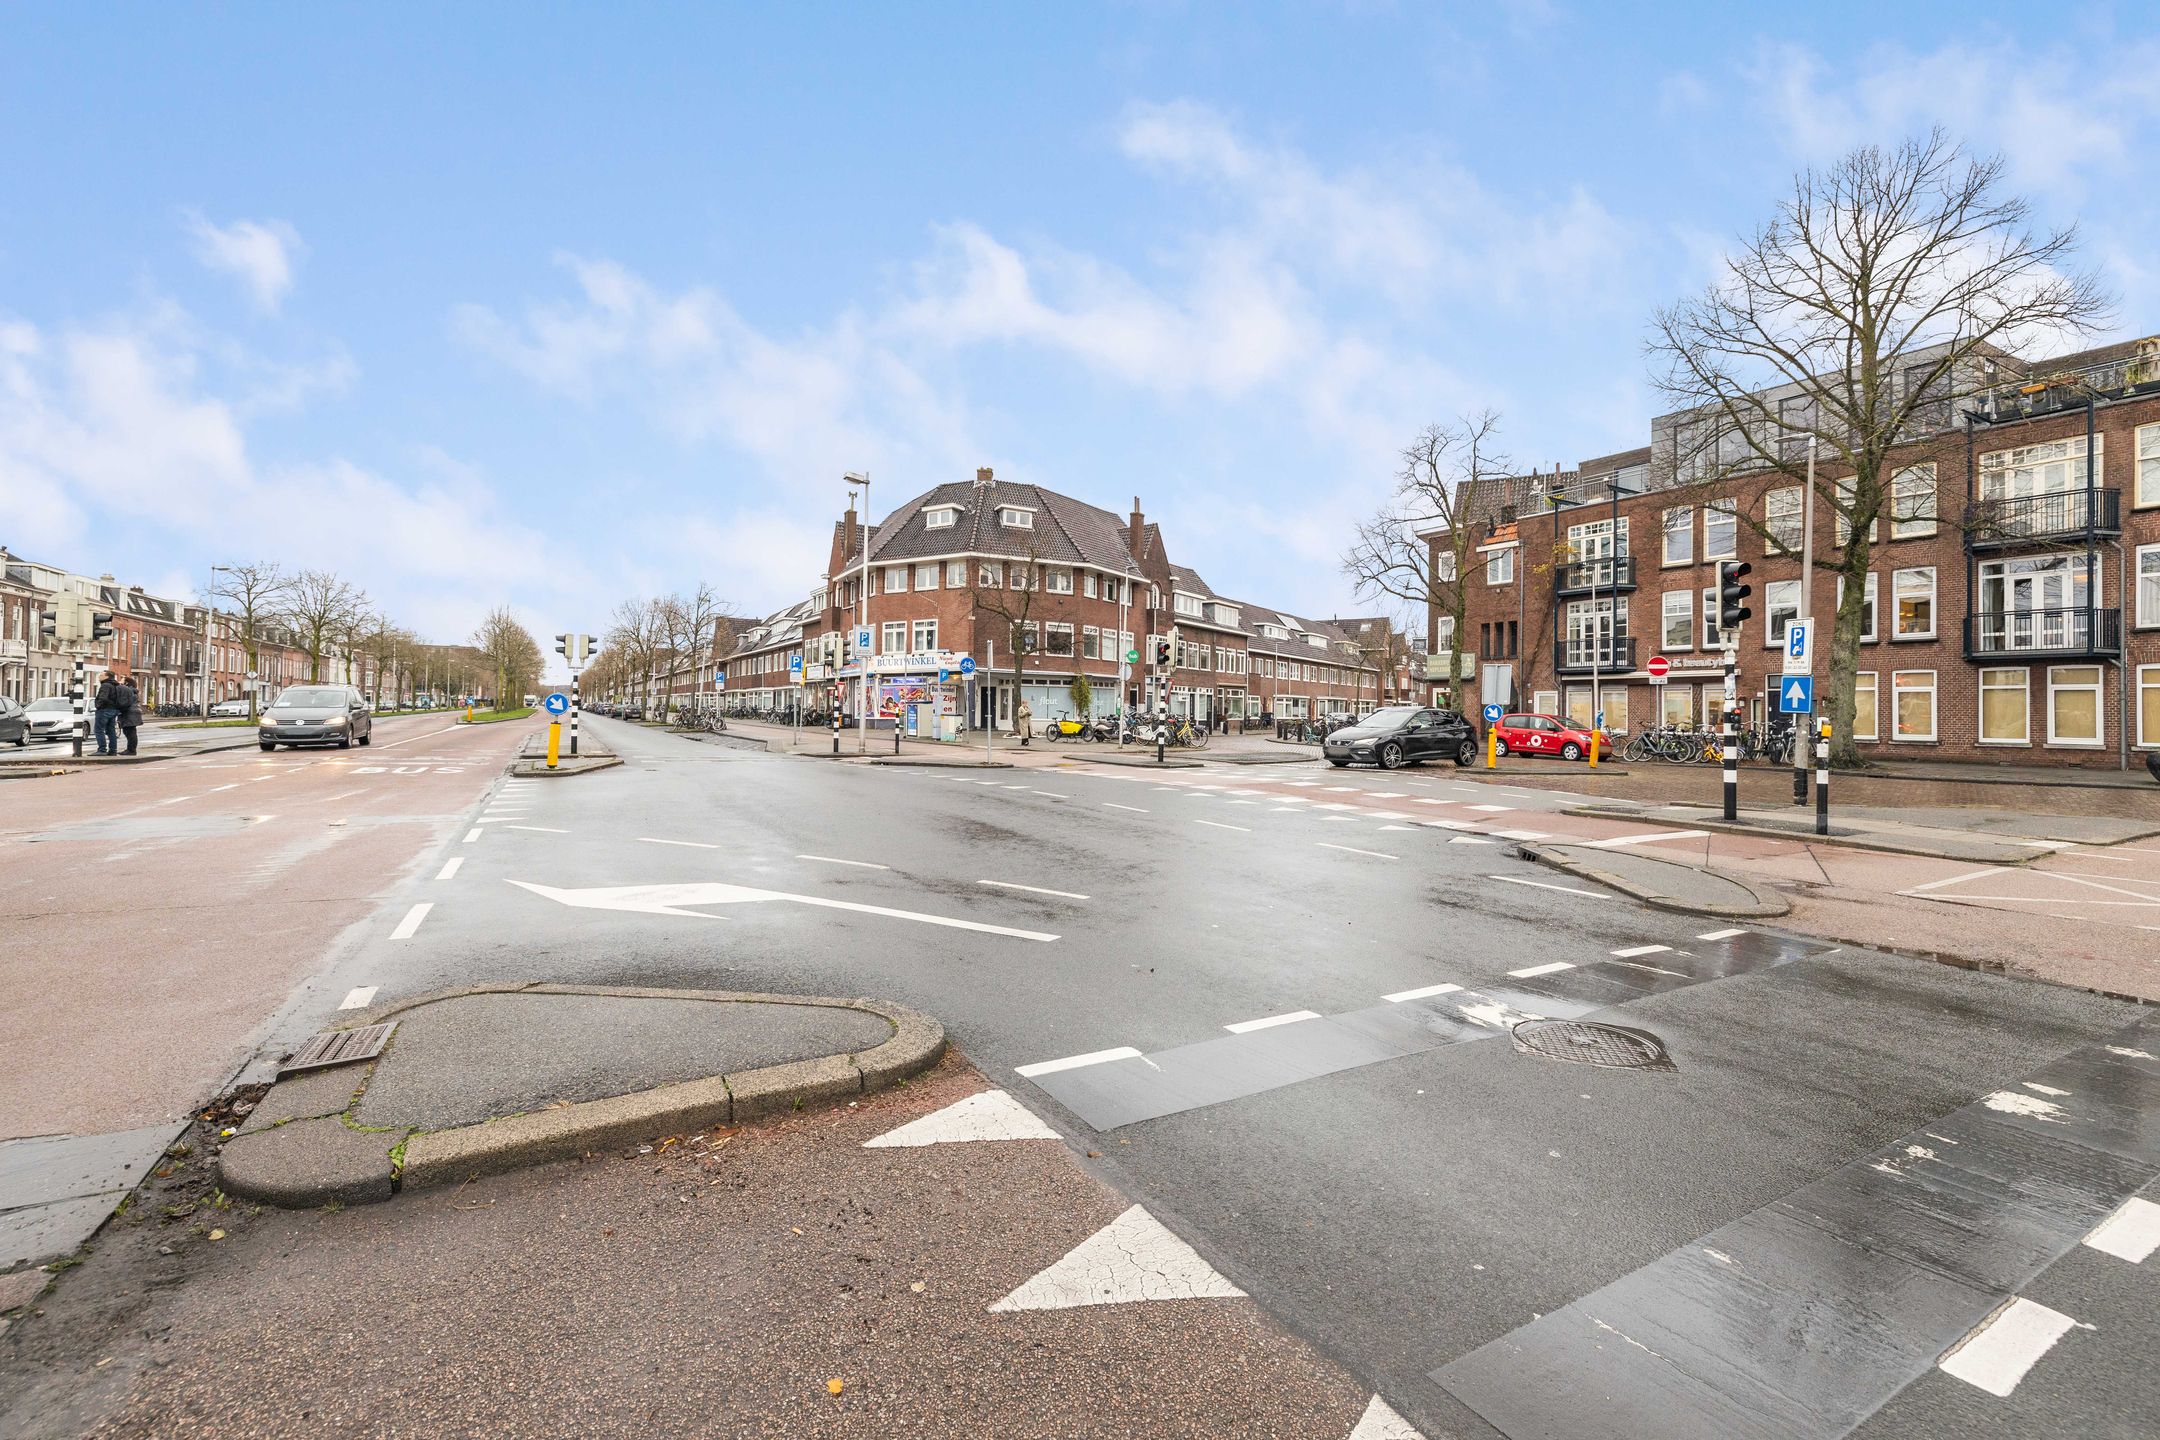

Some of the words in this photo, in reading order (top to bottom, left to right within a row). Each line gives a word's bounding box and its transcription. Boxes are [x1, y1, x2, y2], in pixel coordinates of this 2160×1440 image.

[1793, 628, 1803, 645] P
[877, 656, 937, 667] BUURTWINKEL
[1683, 657, 1725, 669] beautyb
[348, 766, 466, 774] BUS
